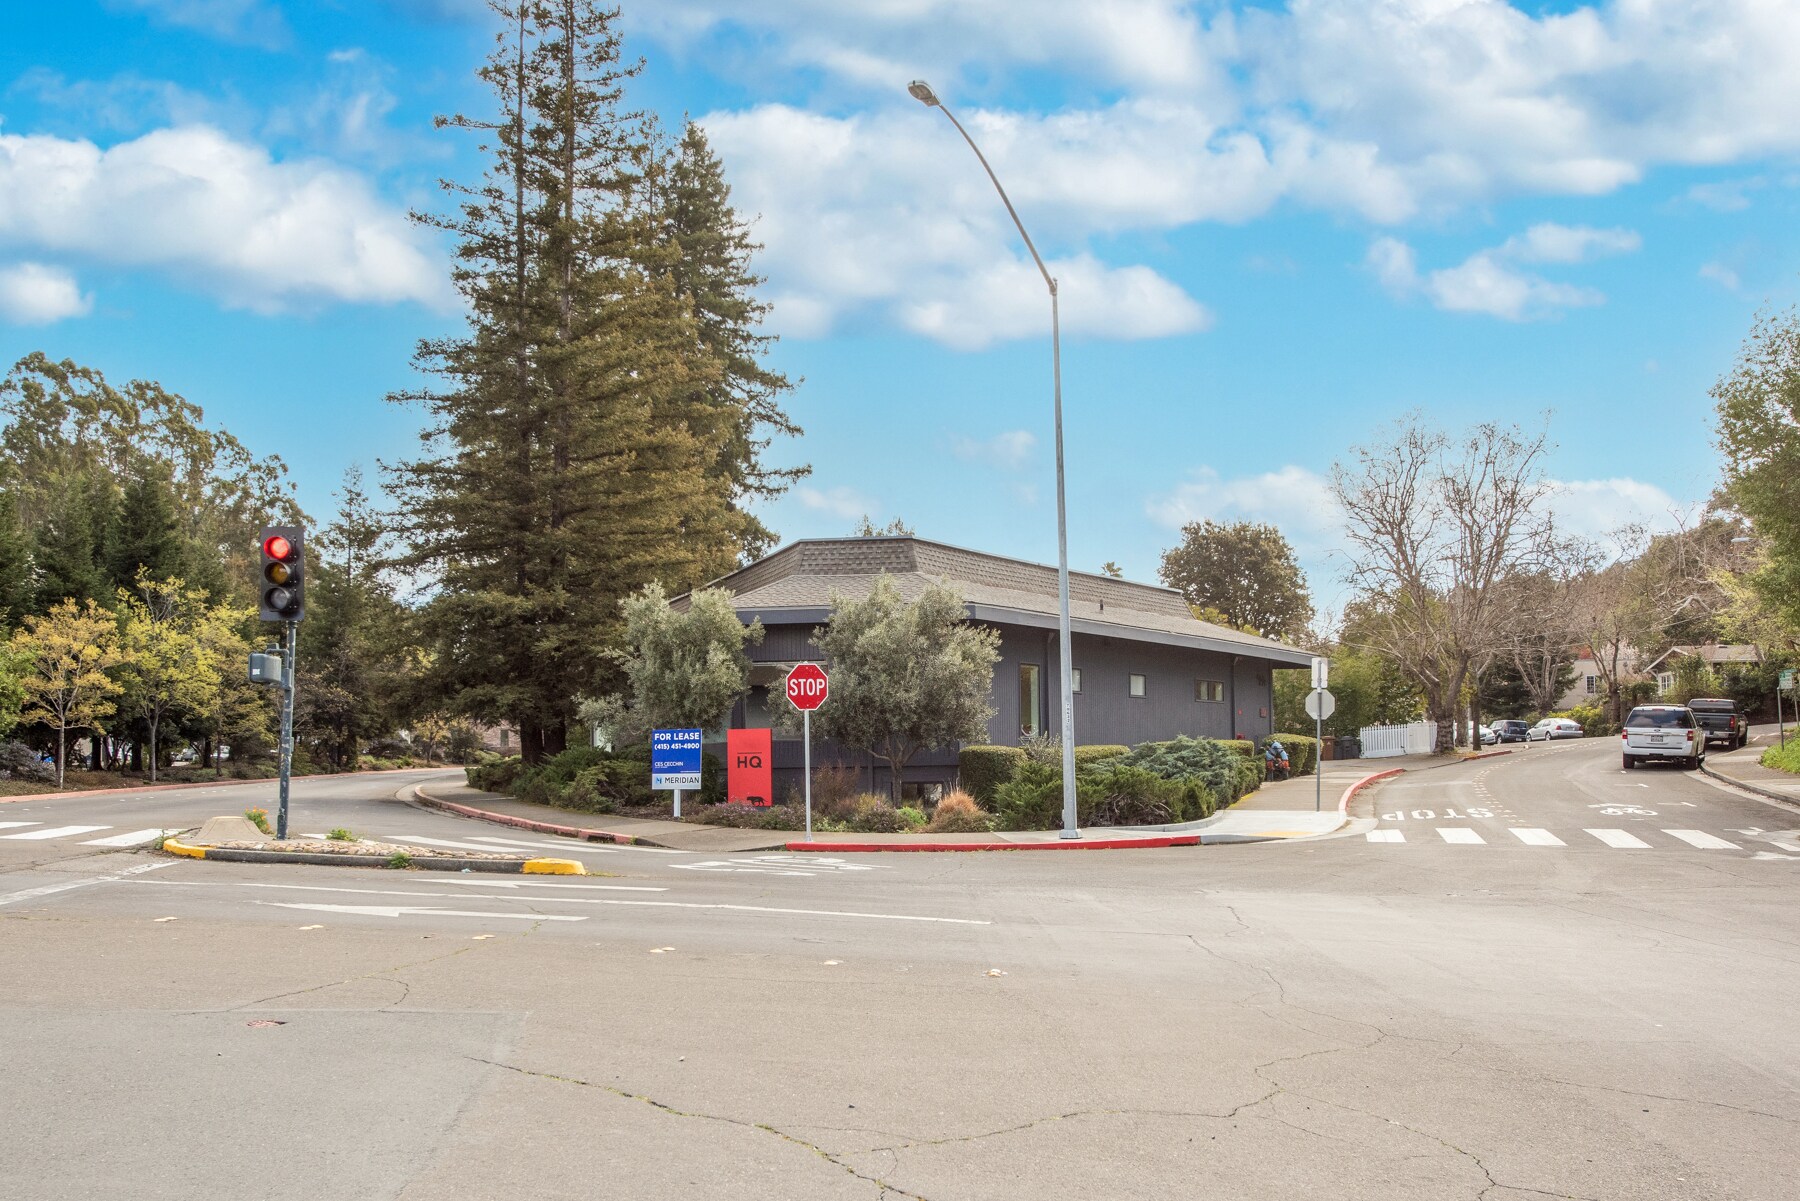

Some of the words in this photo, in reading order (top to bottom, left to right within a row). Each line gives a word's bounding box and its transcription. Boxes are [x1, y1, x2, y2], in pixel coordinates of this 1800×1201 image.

[789, 678, 825, 696] STOP
[673, 732, 700, 740] LEASE
[737, 755, 762, 768] HQ
[1381, 808, 1496, 820] STOP
